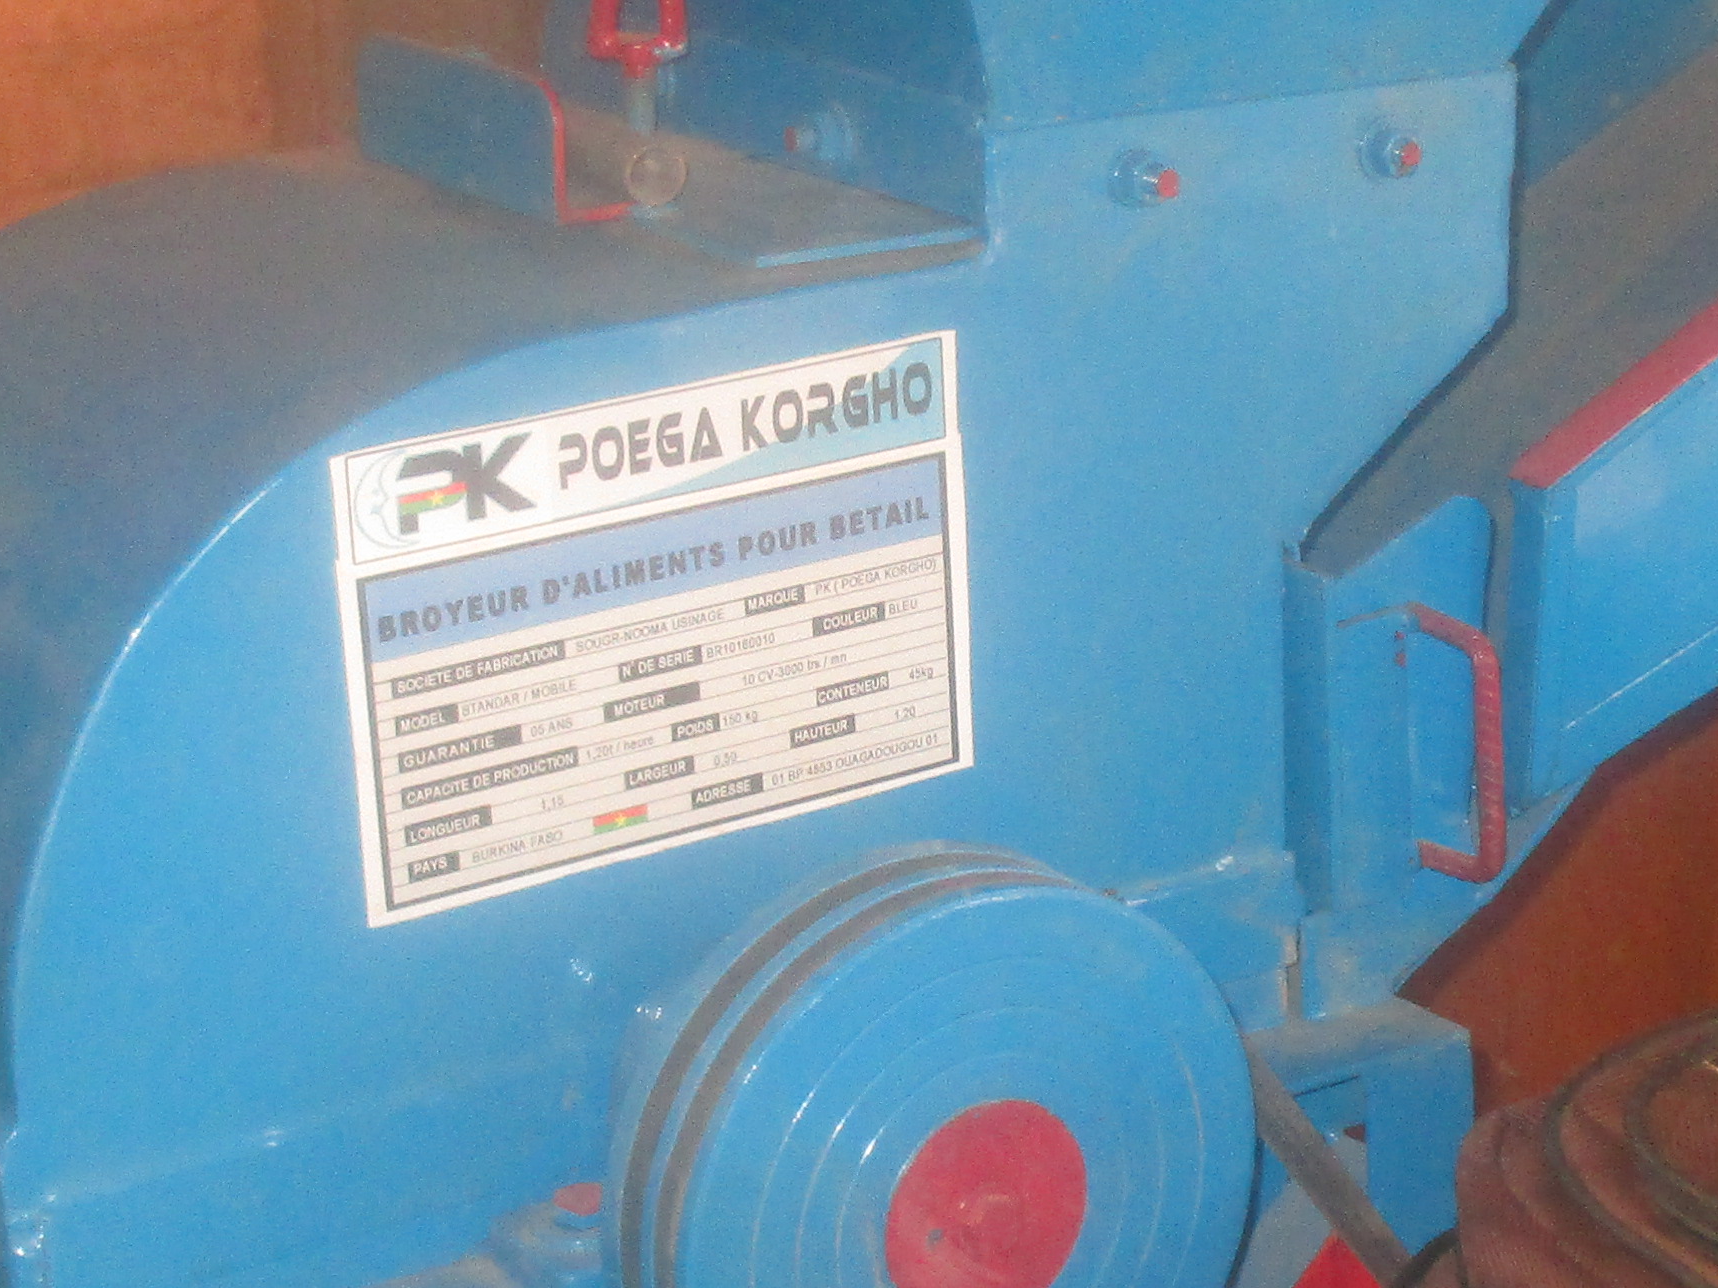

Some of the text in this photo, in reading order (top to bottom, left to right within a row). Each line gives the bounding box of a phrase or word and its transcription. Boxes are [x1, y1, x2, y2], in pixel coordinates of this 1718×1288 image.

[397, 361, 933, 537] PK POEGA KORGHO
[377, 496, 931, 644] BROYEUR D'ALIMENTS POUR BETAIL
[397, 672, 452, 694] SOCIETE
[456, 665, 473, 680] DE
[478, 645, 557, 674] FABRICATION
[672, 608, 725, 630] USINAGE
[749, 585, 799, 610] MARQUE
[815, 583, 832, 596] PK
[842, 571, 880, 590] POEGA
[401, 713, 445, 731] MODEL
[532, 678, 577, 701] MOBILE
[639, 660, 655, 674] DE
[659, 649, 694, 669] SERIE
[823, 606, 878, 630] COULEUR
[889, 598, 918, 615] BLEU
[404, 734, 495, 768] GUARANTIE
[530, 725, 544, 738] 05
[547, 716, 573, 734] ANS
[614, 694, 665, 717] MOTEUR
[743, 672, 755, 686] 10
[407, 778, 469, 804] CAPACITE
[473, 773, 490, 787] DE
[494, 752, 574, 784] PRODUCTION
[677, 720, 713, 738] POIDS
[818, 675, 887, 703] CONTENEUR
[410, 814, 480, 843] LONGUEUR
[629, 761, 686, 786] LARGEUR
[794, 718, 848, 744] HAUTEUR
[414, 856, 448, 877] PAYS
[472, 839, 526, 864] BURKINA
[695, 779, 751, 804] ADRESSE
